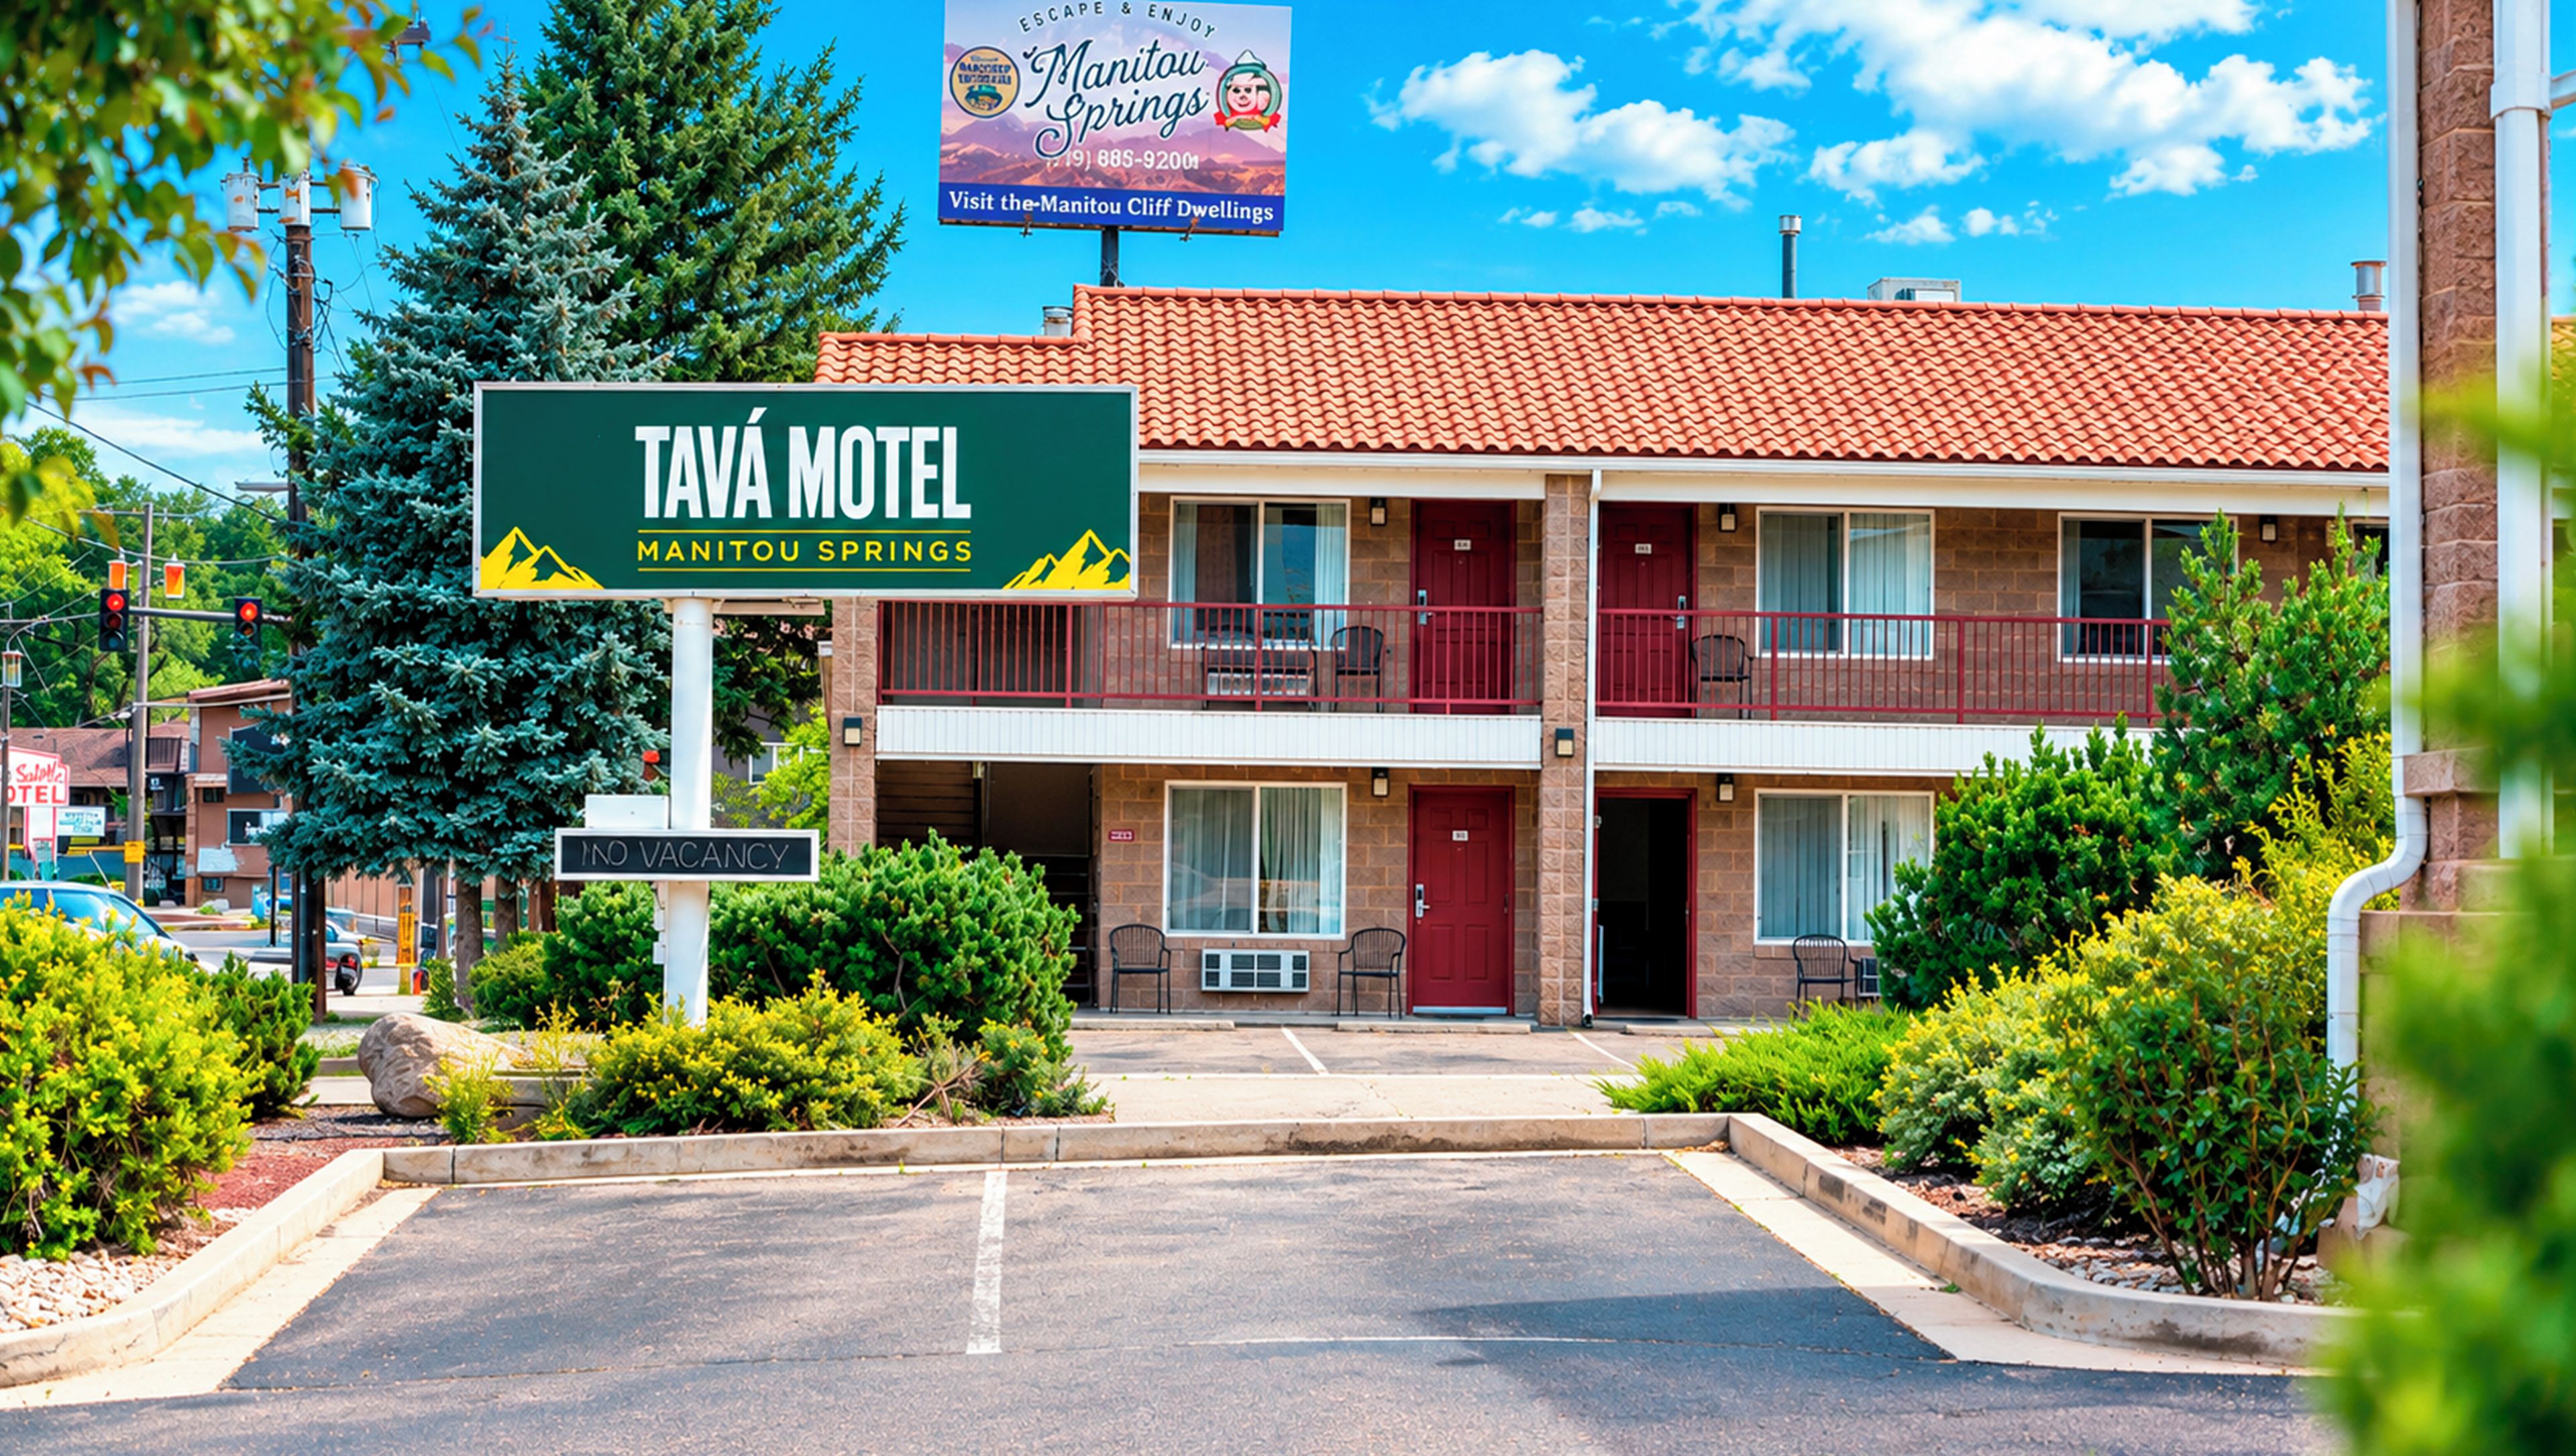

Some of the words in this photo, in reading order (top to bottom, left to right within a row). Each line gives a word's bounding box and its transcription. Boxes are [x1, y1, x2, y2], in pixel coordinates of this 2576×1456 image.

[1019, 1, 1102, 32] ESCAPE
[1121, 1, 1132, 14] &
[1147, 3, 1215, 38] ENJOY
[1023, 39, 1206, 107] Manitou
[1035, 87, 1209, 158] Springs
[949, 191, 994, 210] Visit
[1041, 195, 1121, 214] Manitou
[1127, 197, 1173, 216] Cliff
[1177, 200, 1274, 225] Dwellings
[635, 407, 772, 519] TAVÁ
[788, 425, 971, 519] MOTEL
[637, 540, 800, 562] MANITOU
[818, 540, 972, 562] SPRINGS
[7, 784, 65, 804] OTEL
[639, 841, 789, 870] VACANCY
